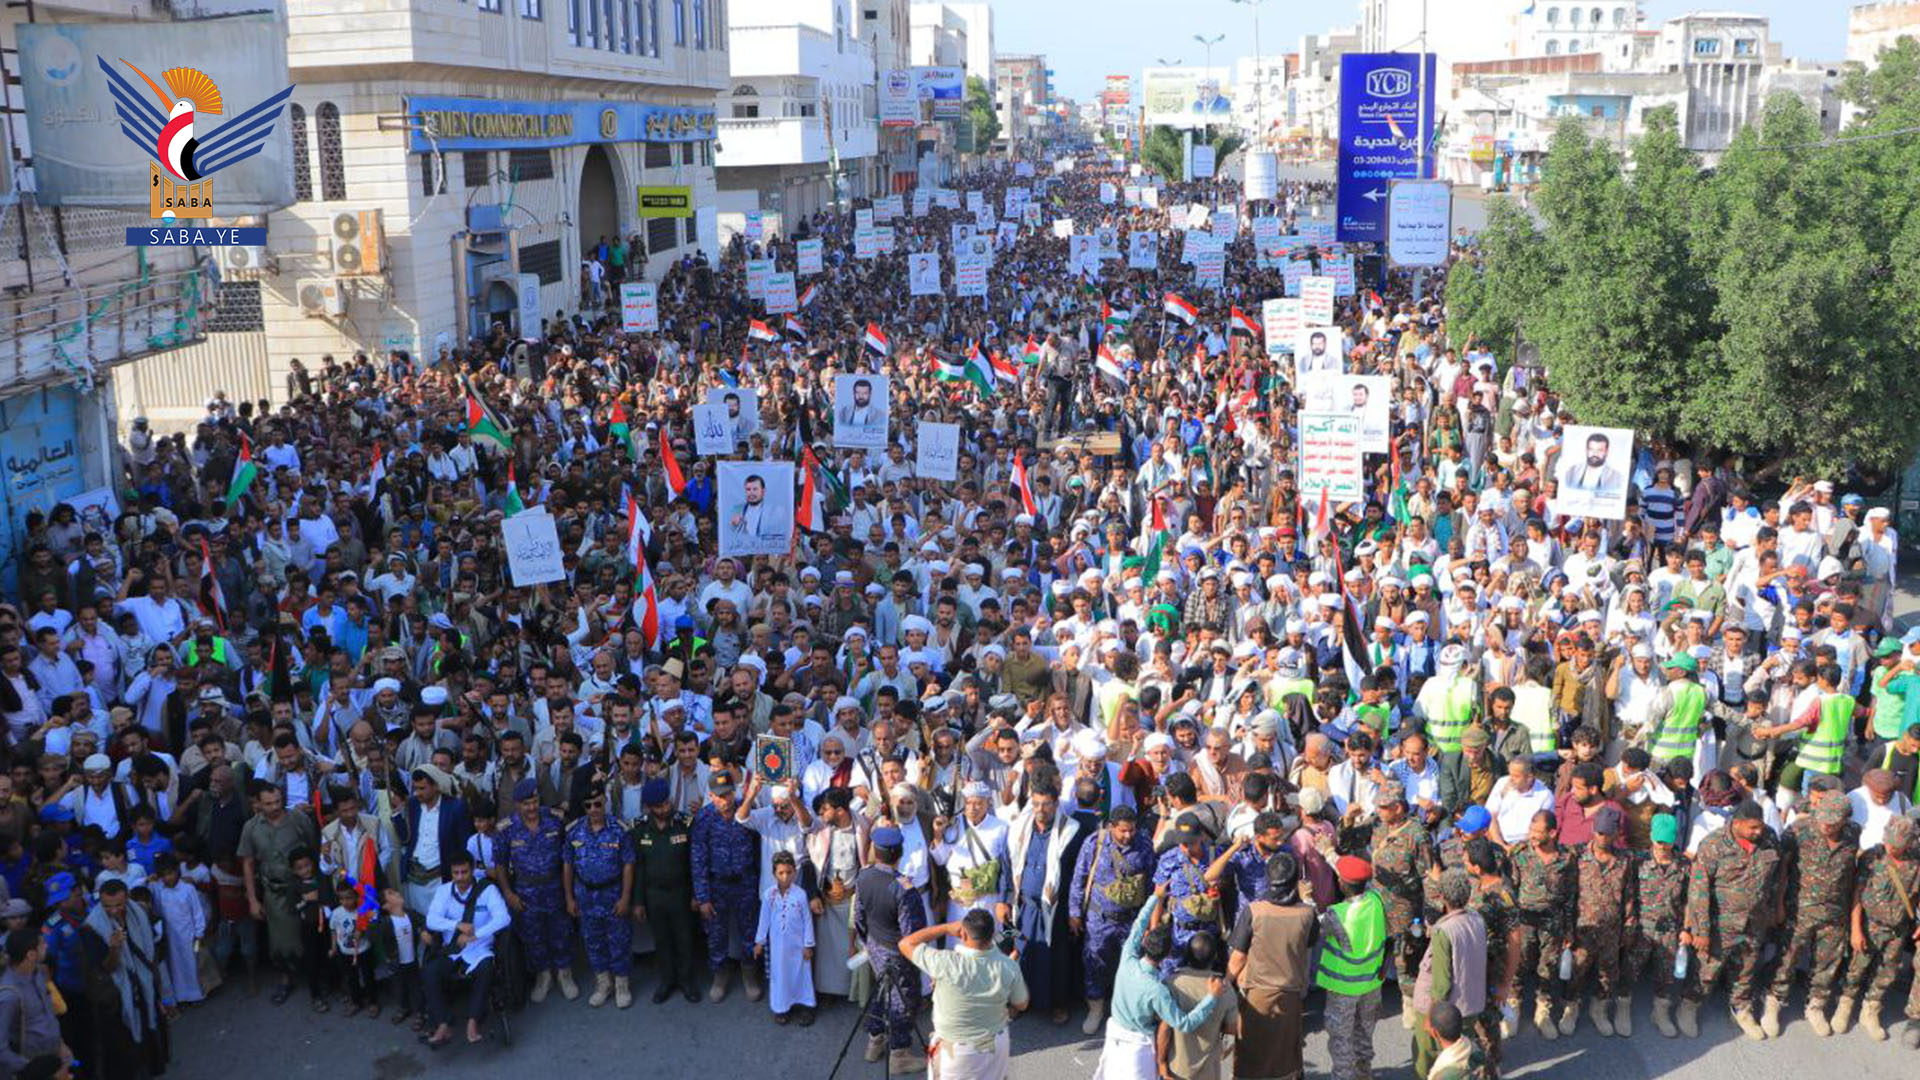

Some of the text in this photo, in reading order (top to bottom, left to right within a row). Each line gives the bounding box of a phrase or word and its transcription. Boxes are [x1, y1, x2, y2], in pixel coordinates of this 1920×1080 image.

[1371, 72, 1407, 94] YCB
[473, 113, 545, 137] COMMERCIAL
[1336, 422, 1357, 433] الله
